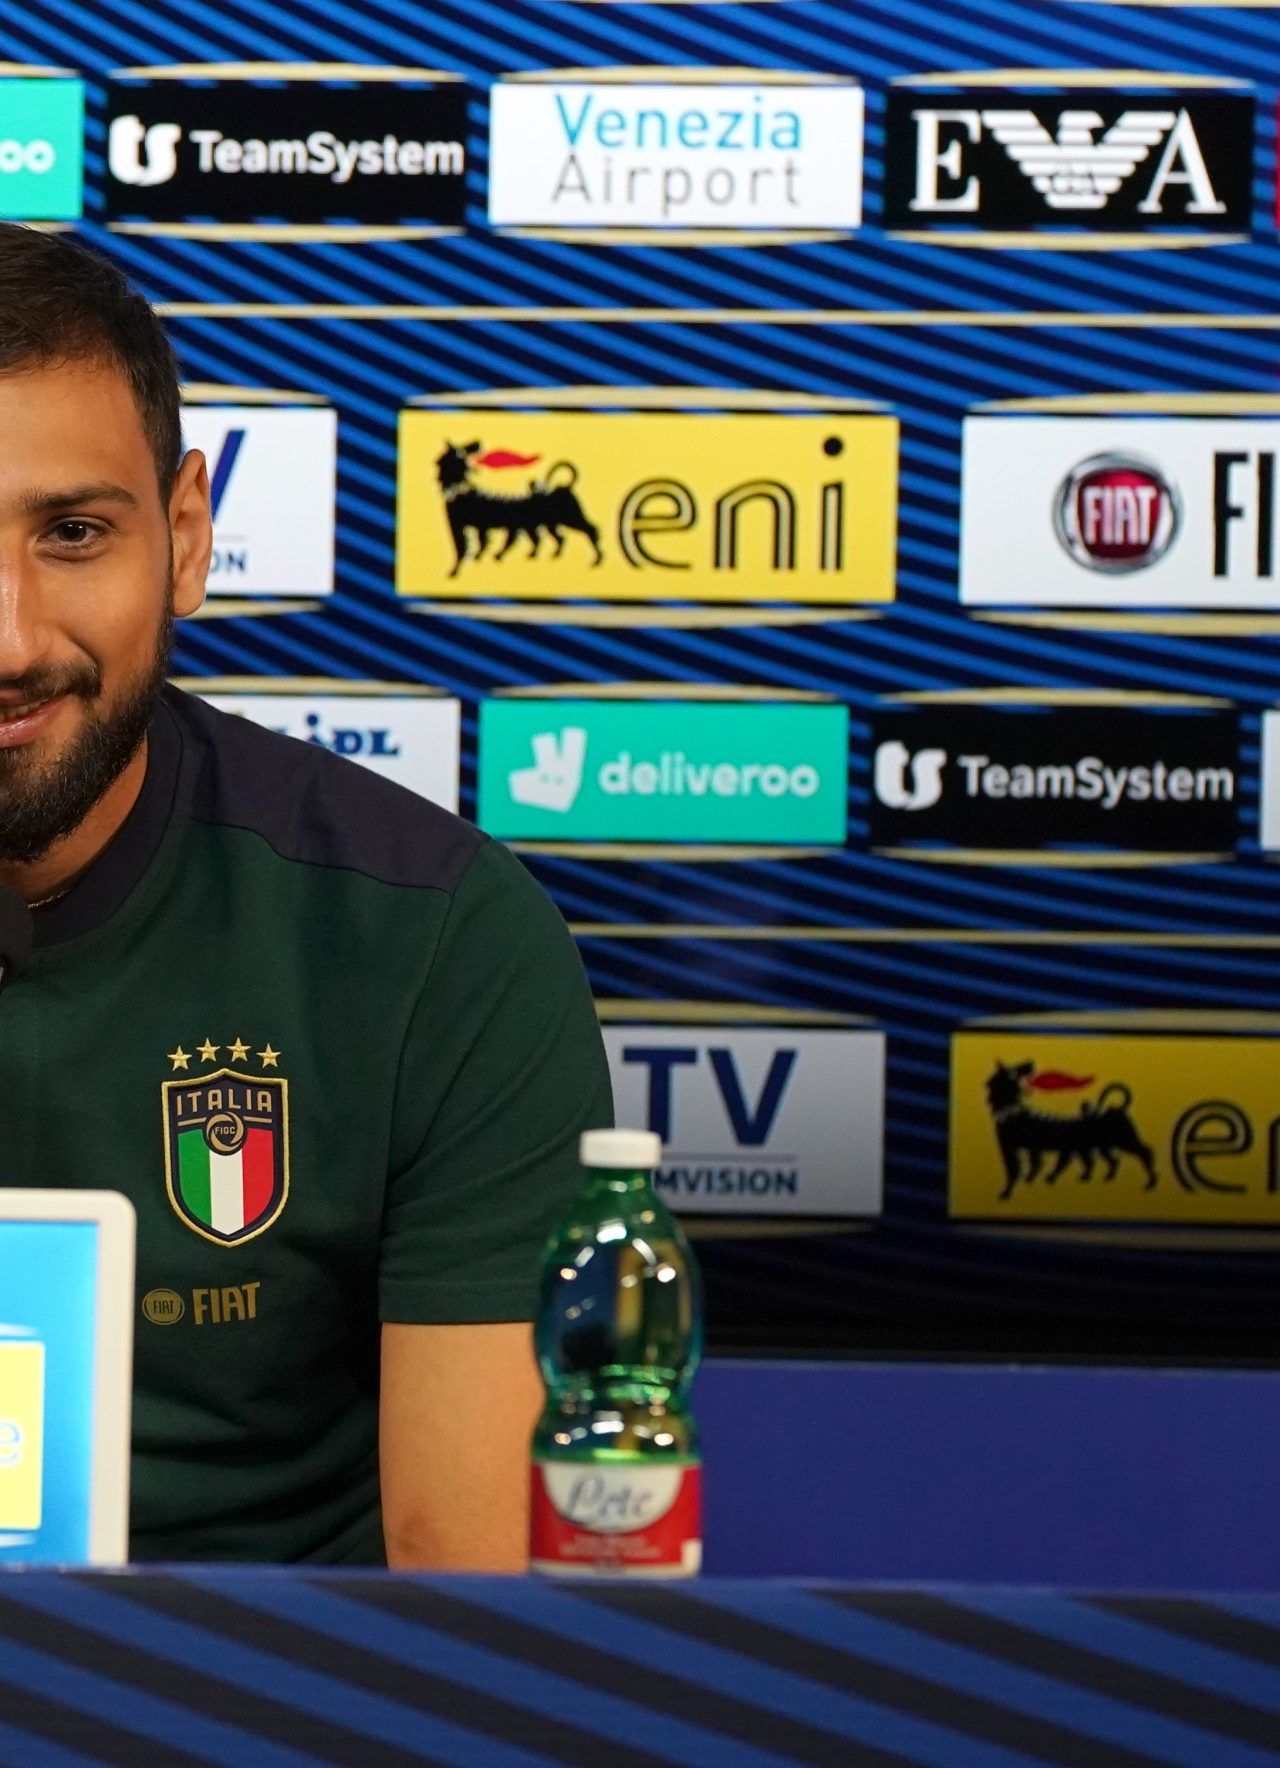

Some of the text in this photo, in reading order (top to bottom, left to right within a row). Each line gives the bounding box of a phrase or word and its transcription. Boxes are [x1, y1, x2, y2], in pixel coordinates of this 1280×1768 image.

[554, 92, 802, 151] Venezia
[190, 130, 464, 182] TeamSystem
[551, 152, 798, 216] Airport
[619, 435, 845, 572] eni
[1082, 485, 1157, 546] FIAT
[597, 750, 820, 798] deliveroo
[958, 756, 1234, 808] TeamSystem
[176, 1088, 273, 1116] ITALIA
[622, 1046, 797, 1146] TV
[654, 1168, 798, 1196] MVISION
[153, 1300, 174, 1314] FIAT
[192, 1281, 261, 1325] FIAT
